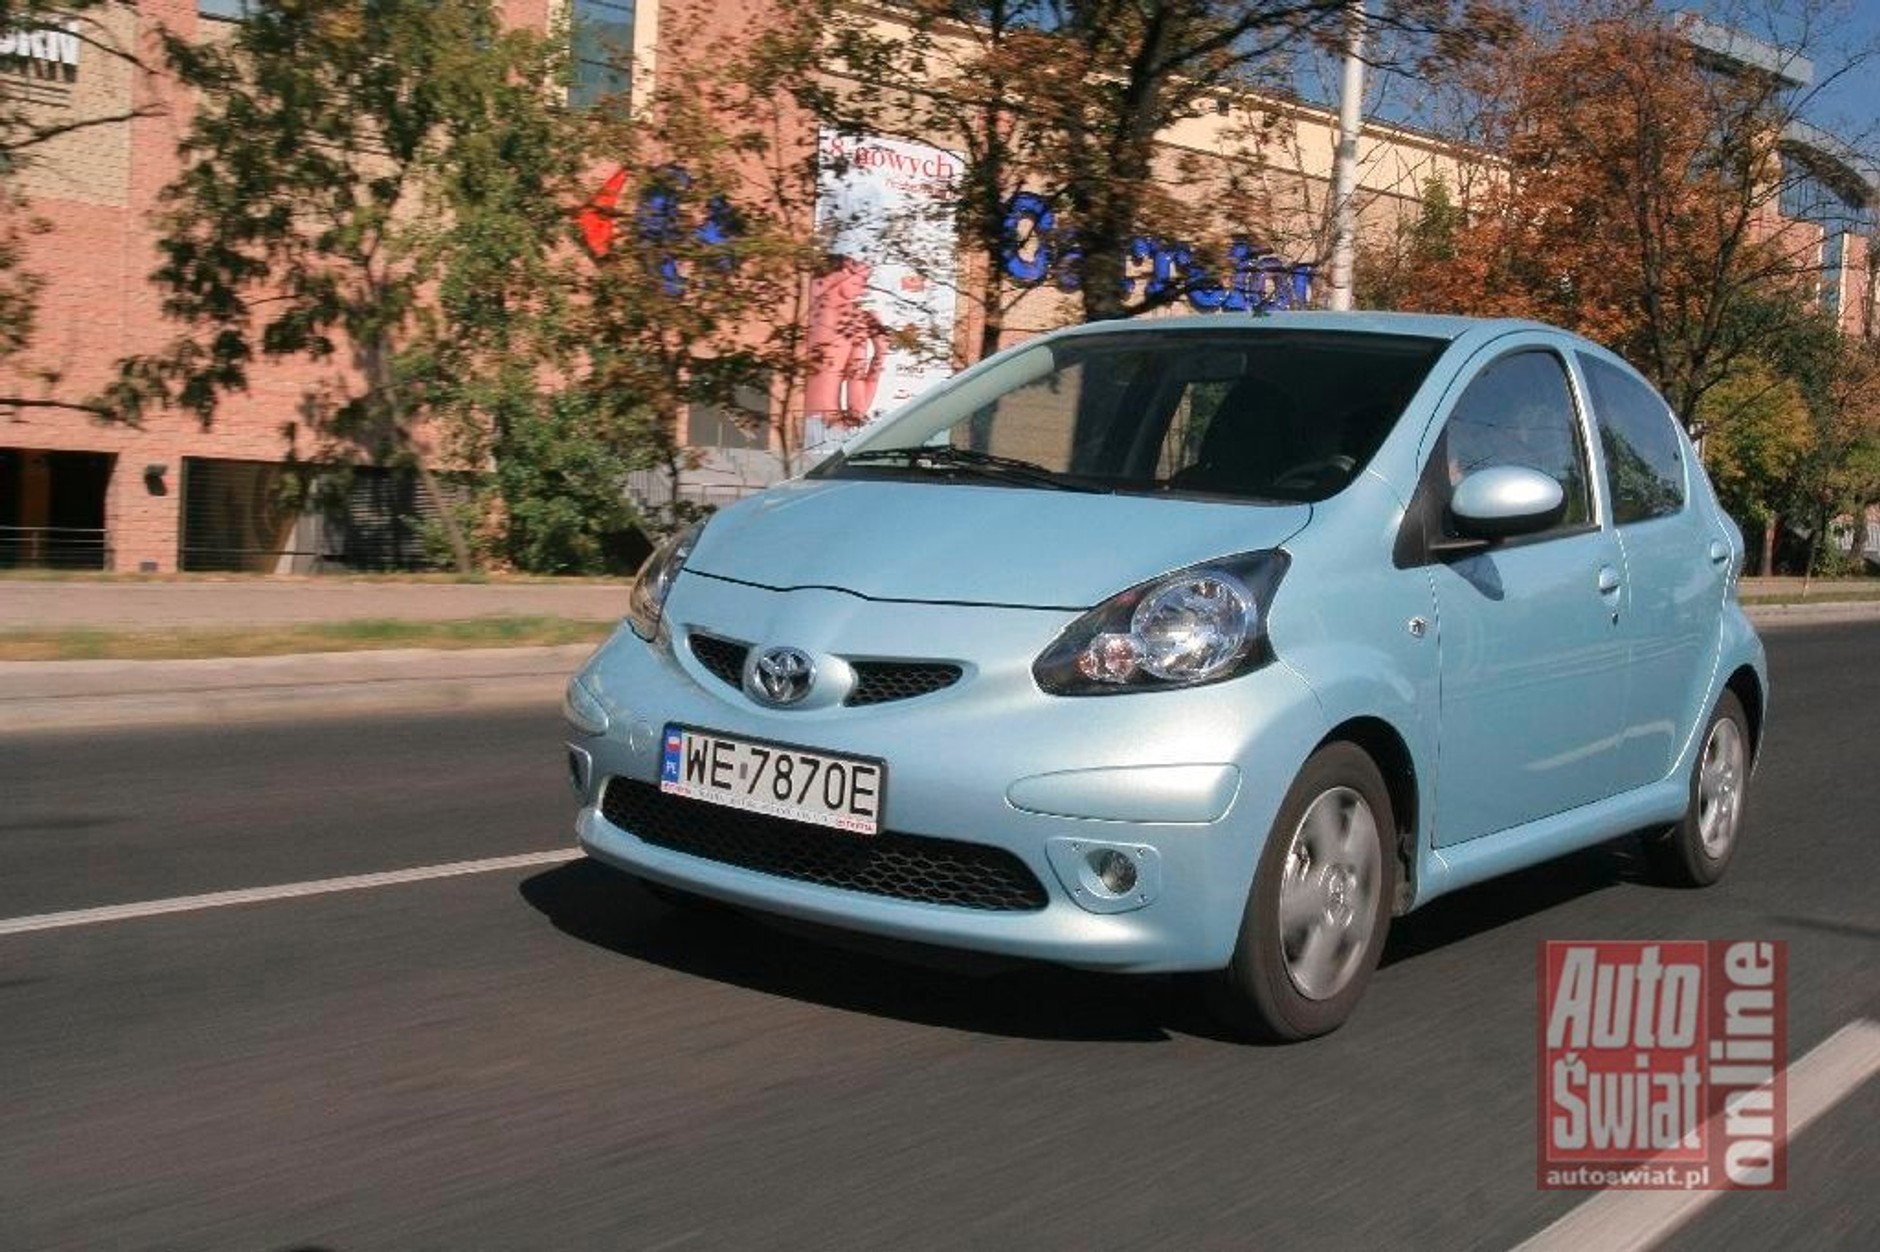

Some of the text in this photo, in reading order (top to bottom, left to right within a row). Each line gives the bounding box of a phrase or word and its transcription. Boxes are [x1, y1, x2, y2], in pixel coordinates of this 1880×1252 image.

[665, 760, 677, 774] PL
[686, 735, 736, 791] WE
[748, 747, 876, 817] 7870E
